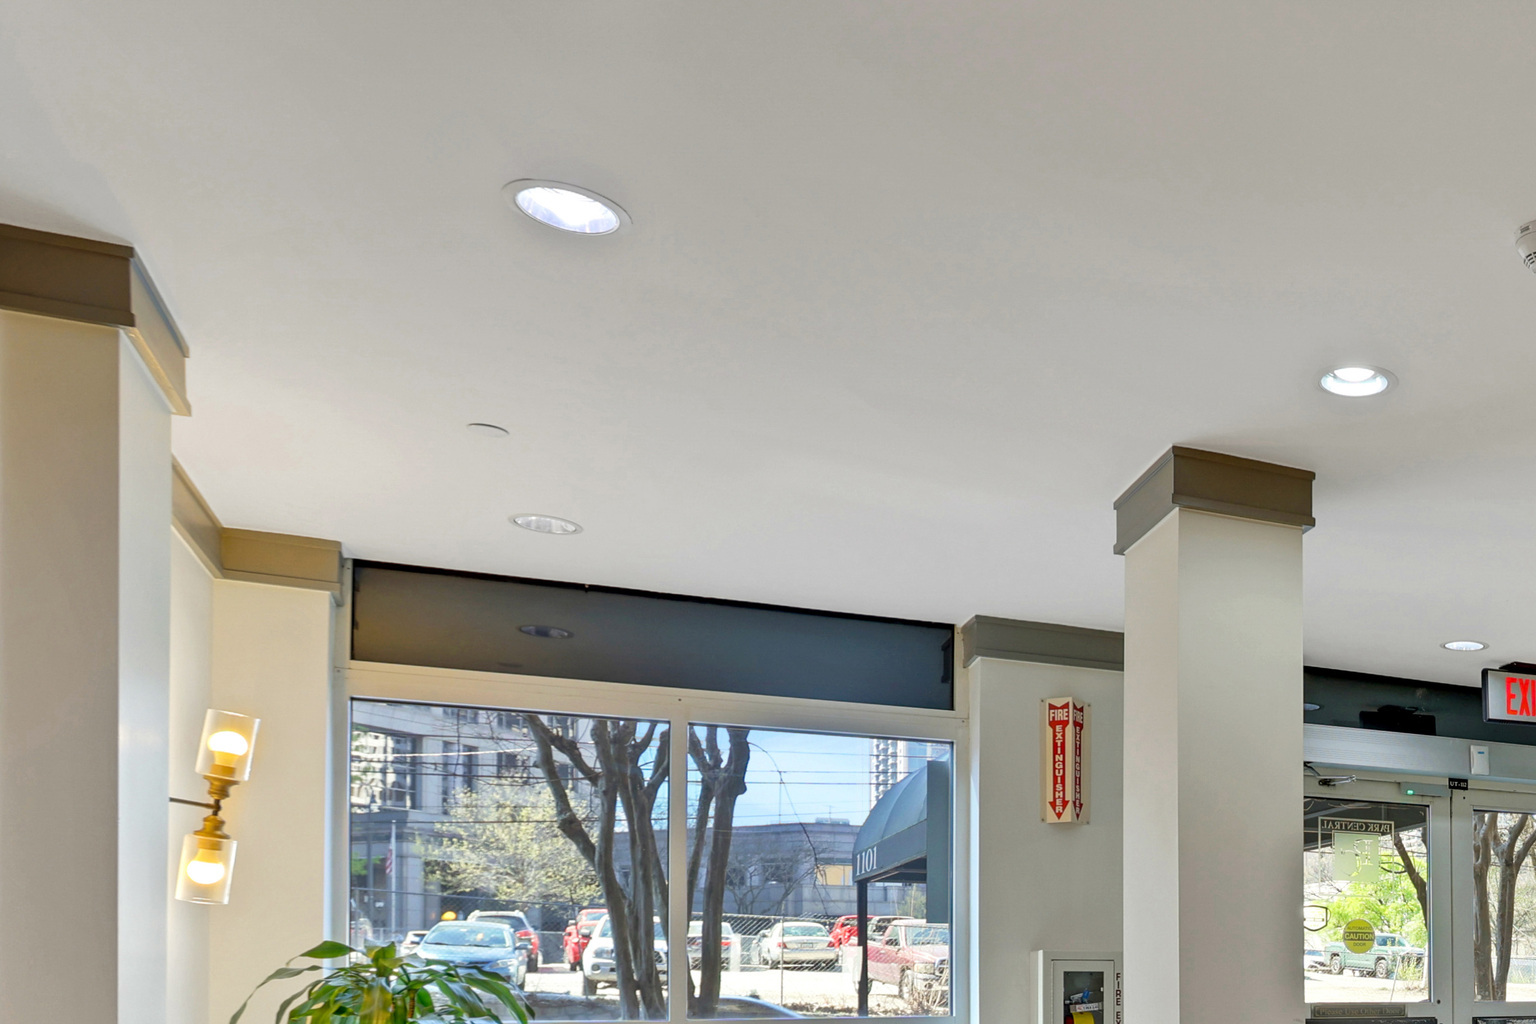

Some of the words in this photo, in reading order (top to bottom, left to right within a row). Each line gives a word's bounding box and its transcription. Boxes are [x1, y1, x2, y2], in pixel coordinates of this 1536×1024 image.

[1049, 709, 1069, 721] FIRE
[1073, 709, 1084, 724] FIRE
[1055, 724, 1064, 813] EXTINGUISHER
[856, 845, 877, 876] 1101
[1344, 932, 1374, 940] CAUTION
[1319, 1007, 1343, 1015] Please
[1345, 1007, 1359, 1015] Use
